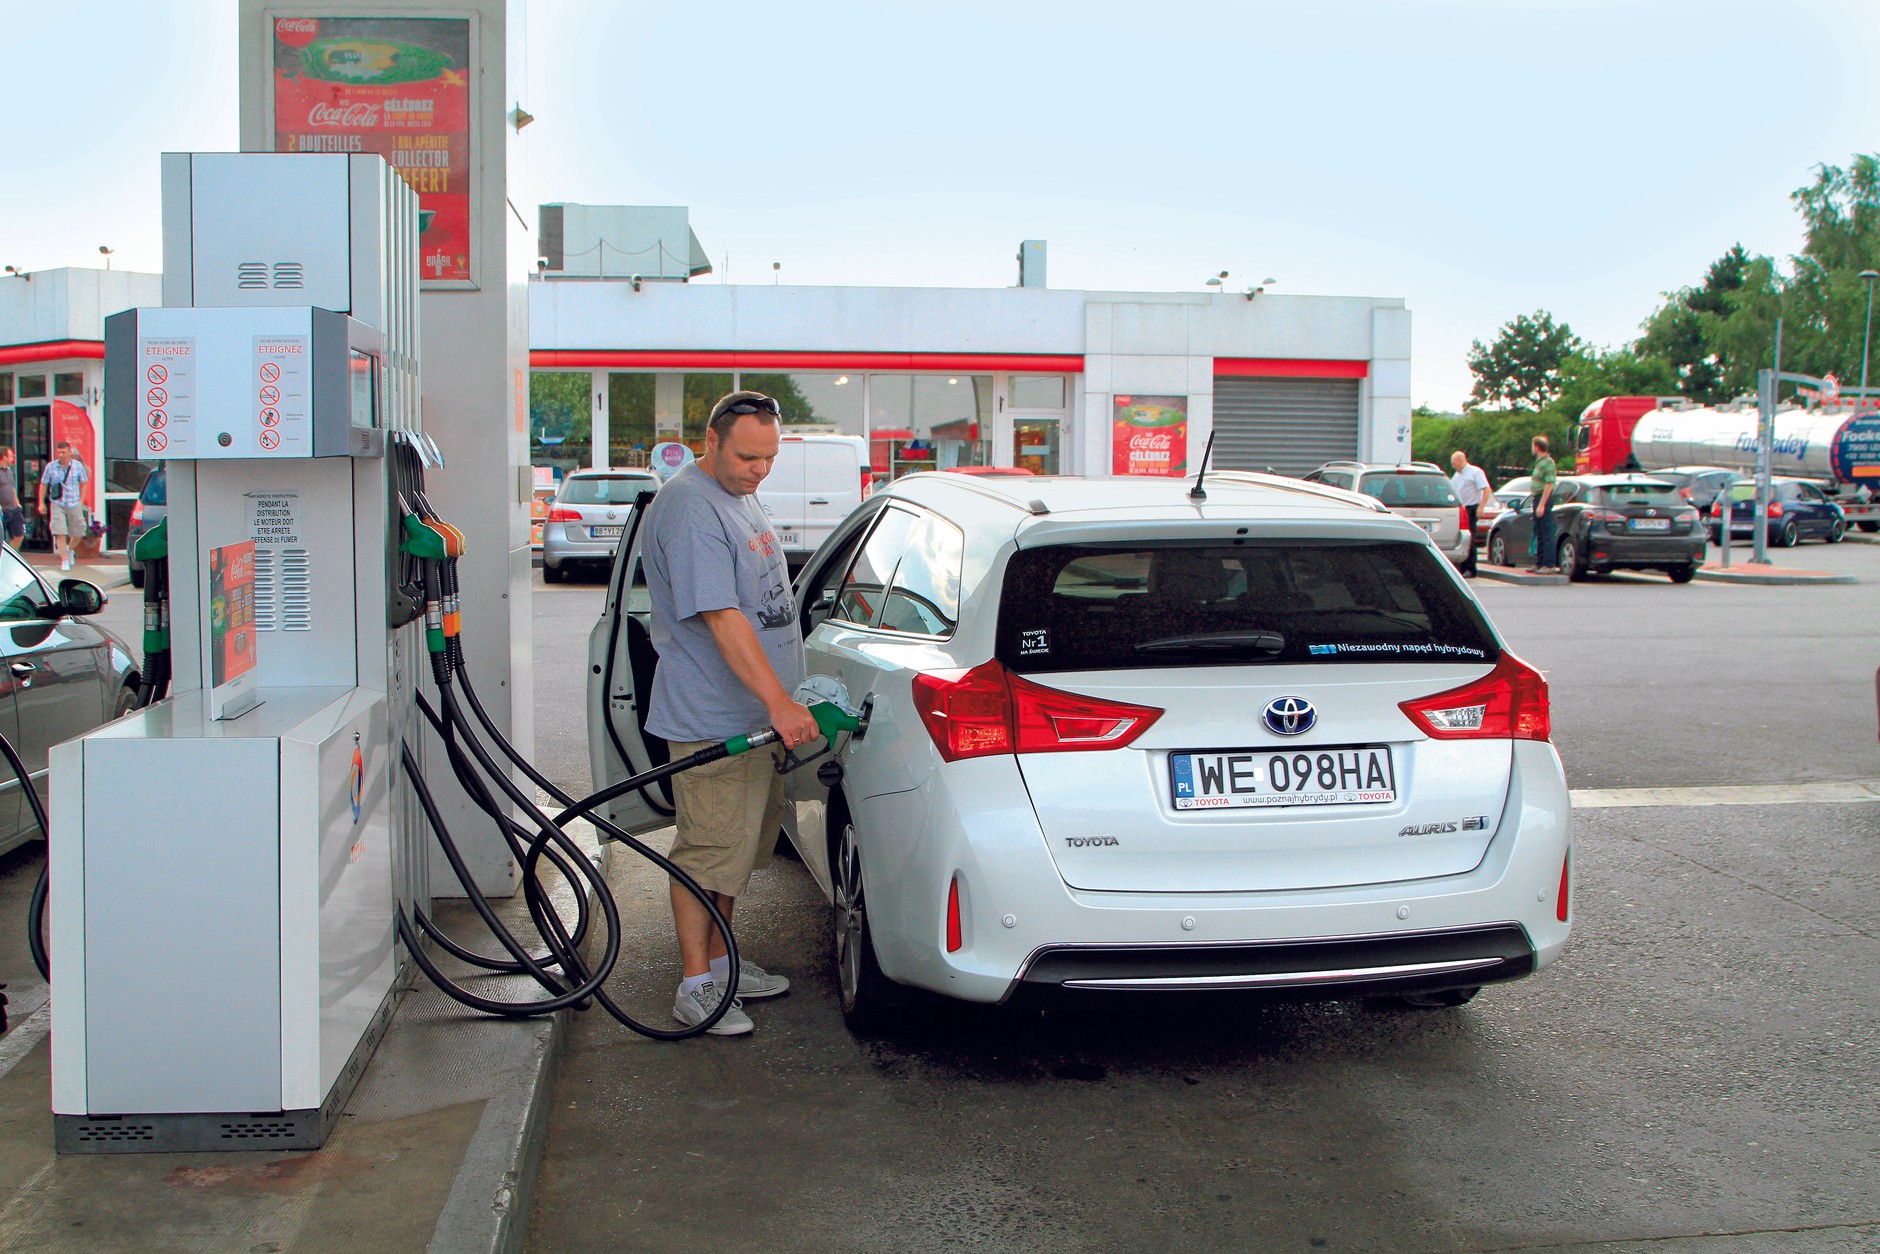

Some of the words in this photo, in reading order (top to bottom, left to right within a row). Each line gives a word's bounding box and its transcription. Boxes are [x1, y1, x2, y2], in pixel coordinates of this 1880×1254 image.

[276, 19, 317, 33] Coca-Cola
[384, 97, 434, 112] CÉLÉBREZ
[308, 102, 382, 127] Coca-Cola
[288, 135, 296, 151] 2
[300, 135, 362, 152] BOUTEILLES
[392, 150, 449, 167] COLLECTOR
[146, 347, 190, 355] ETEIGNEZ
[258, 345, 302, 354] ETEIGNEZ
[1129, 434, 1173, 449] Coca-Cola
[256, 509, 291, 517] DISTRIBUTION
[283, 518, 294, 526] DOIT
[1022, 629, 1047, 637] TOYOTA
[1337, 643, 1400, 653] Niezawodny
[1402, 643, 1433, 653] napęd
[1433, 643, 1485, 658] hybrydowy
[1178, 782, 1192, 793] PL
[1198, 756, 1256, 795] WE
[1268, 752, 1387, 792] 098HA
[1194, 797, 1230, 806] TOYOTA
[1242, 793, 1338, 805] www.poznajhybrydy.pl
[1358, 792, 1392, 801] TOYOTA
[1398, 821, 1457, 837] AURIS
[1065, 836, 1119, 848] TOYOTA
